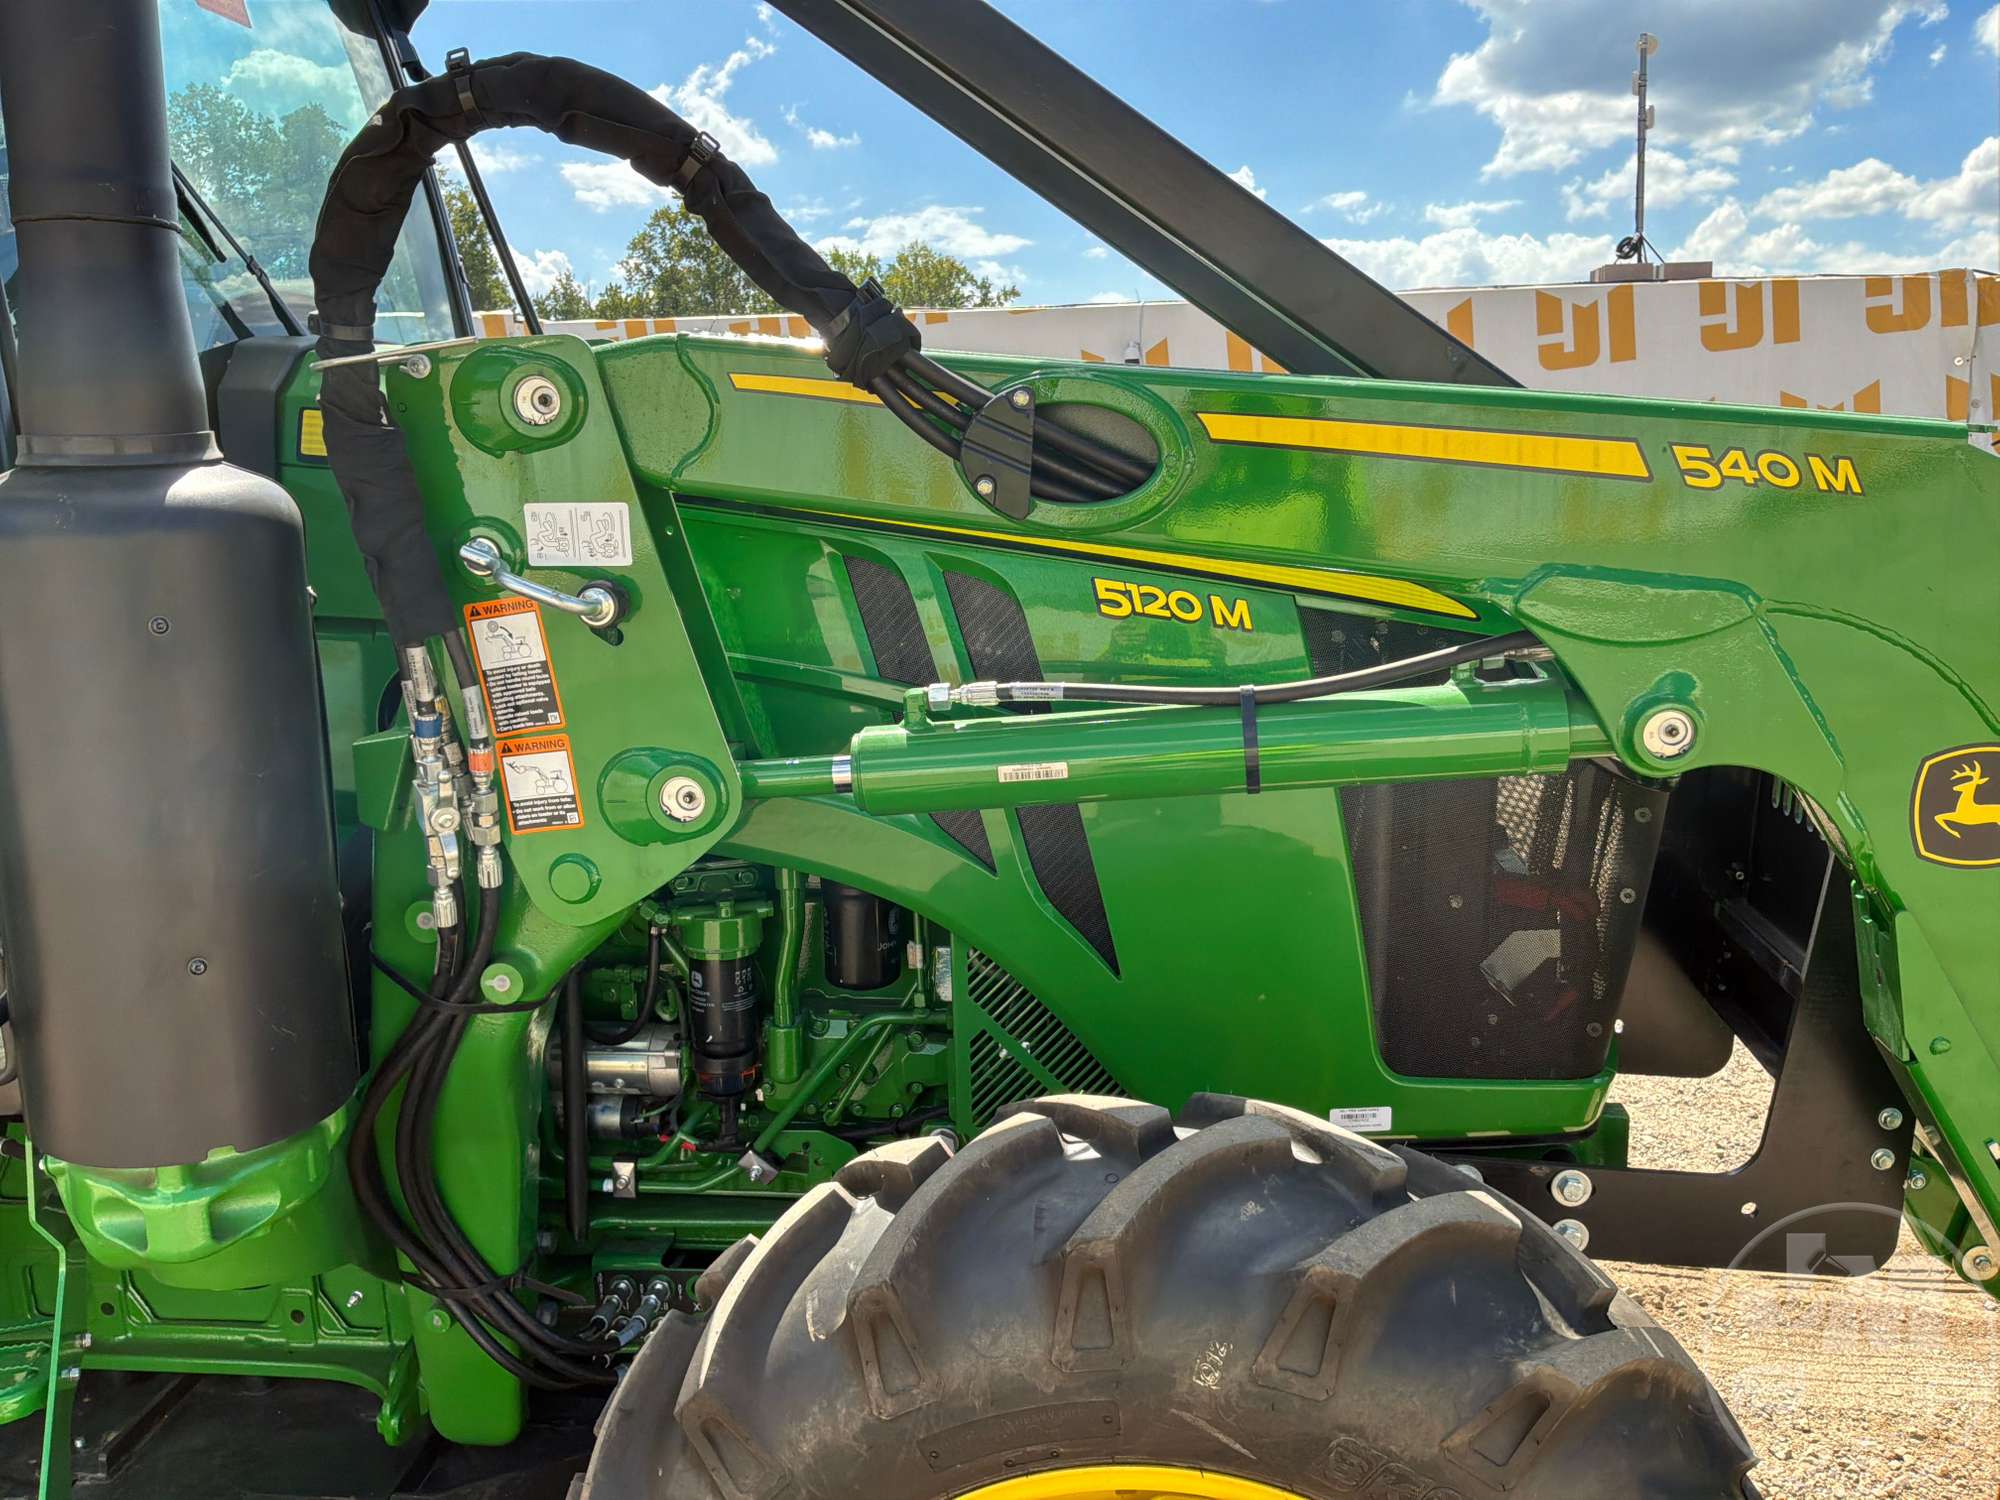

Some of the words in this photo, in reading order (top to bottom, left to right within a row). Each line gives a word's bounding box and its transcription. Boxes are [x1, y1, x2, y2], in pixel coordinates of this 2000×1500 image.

[1671, 444, 1800, 489] 540
[1806, 454, 1864, 495] M
[482, 600, 533, 615] WARNING
[1092, 577, 1203, 622] 5120
[1209, 595, 1253, 631] M
[514, 739, 565, 752] WARNING
